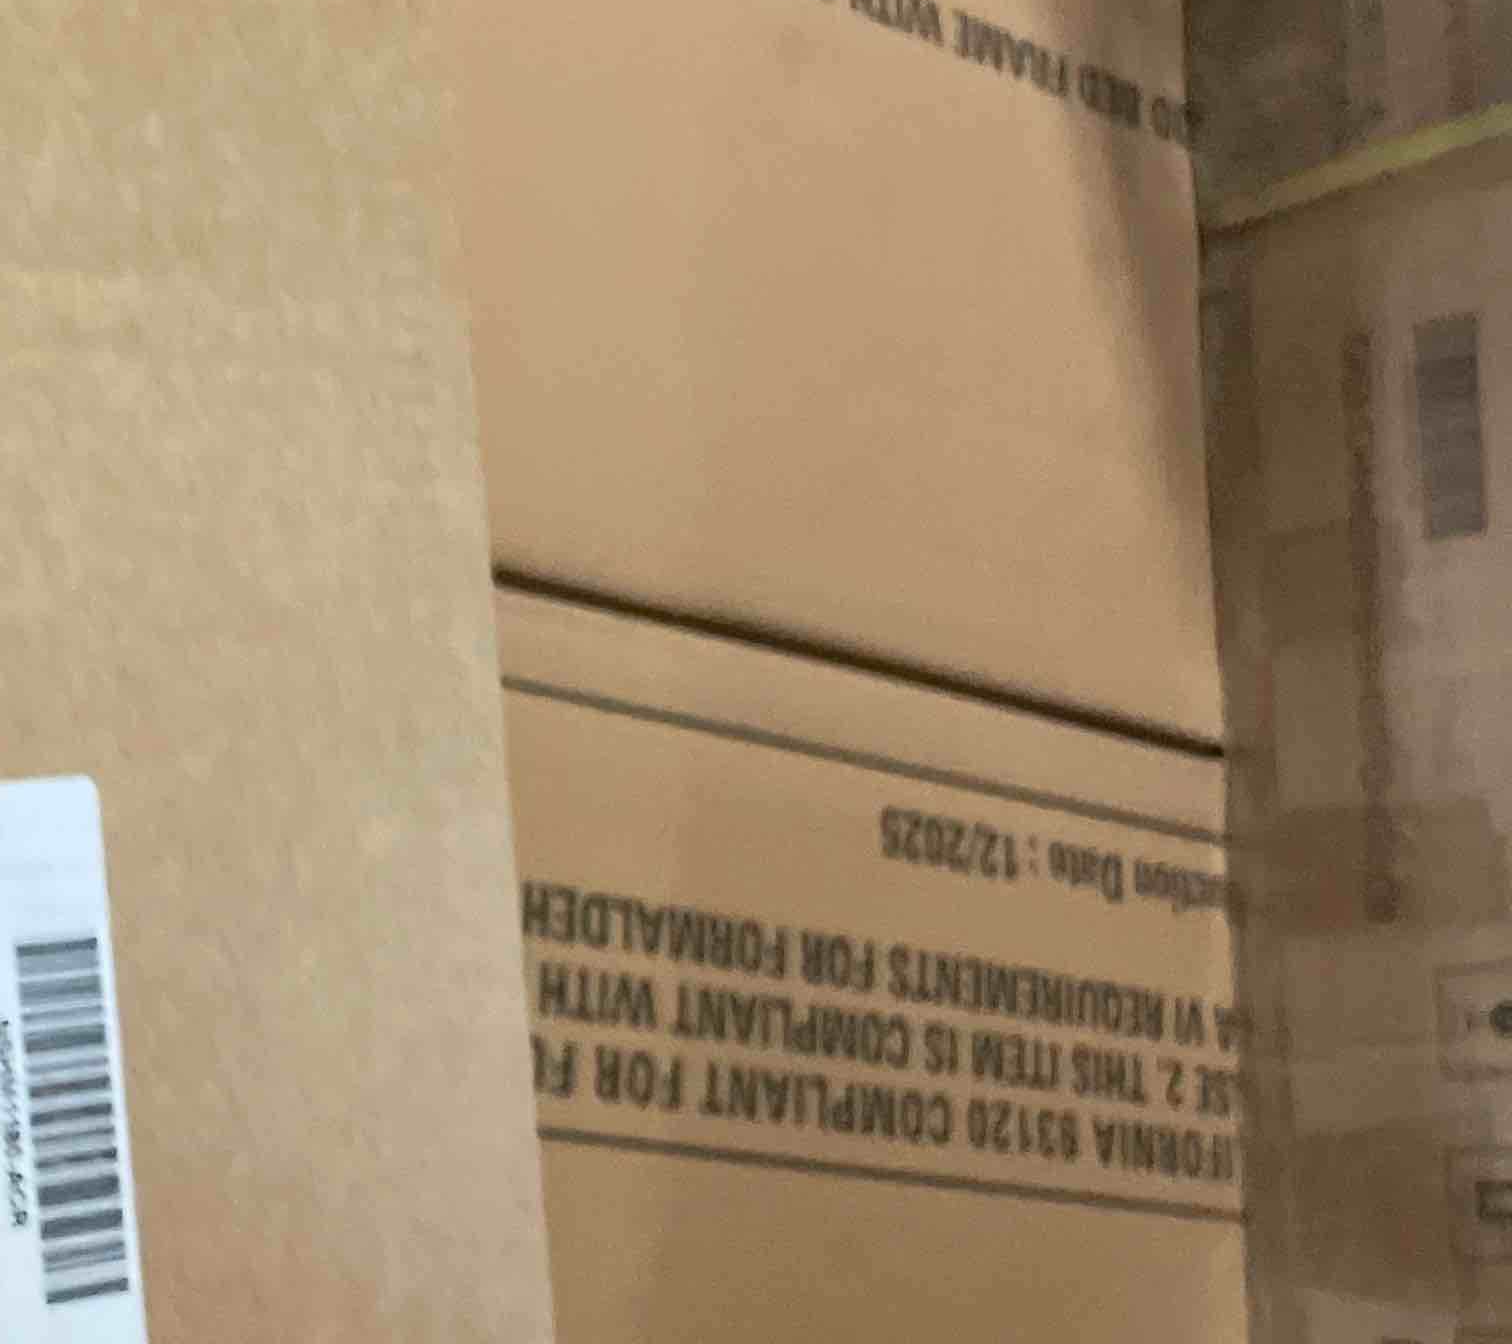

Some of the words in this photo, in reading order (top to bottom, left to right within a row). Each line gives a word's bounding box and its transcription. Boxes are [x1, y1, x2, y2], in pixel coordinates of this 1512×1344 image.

[1048, 840, 1125, 904] Date
[521, 880, 790, 981] FORMALDEH
[799, 929, 877, 990] FOR
[537, 960, 659, 1031] WITH
[673, 977, 913, 1070] COMPLIANT
[887, 949, 1163, 1043] REQUIREMENTS
[593, 1042, 684, 1110] FOR
[923, 1022, 961, 1076] IS
[969, 1033, 1063, 1094] ITEM
[1069, 1042, 1147, 1107] THIS
[696, 1058, 955, 1148] COMPLIANT
[1092, 1114, 1236, 1182] IFORNIA
